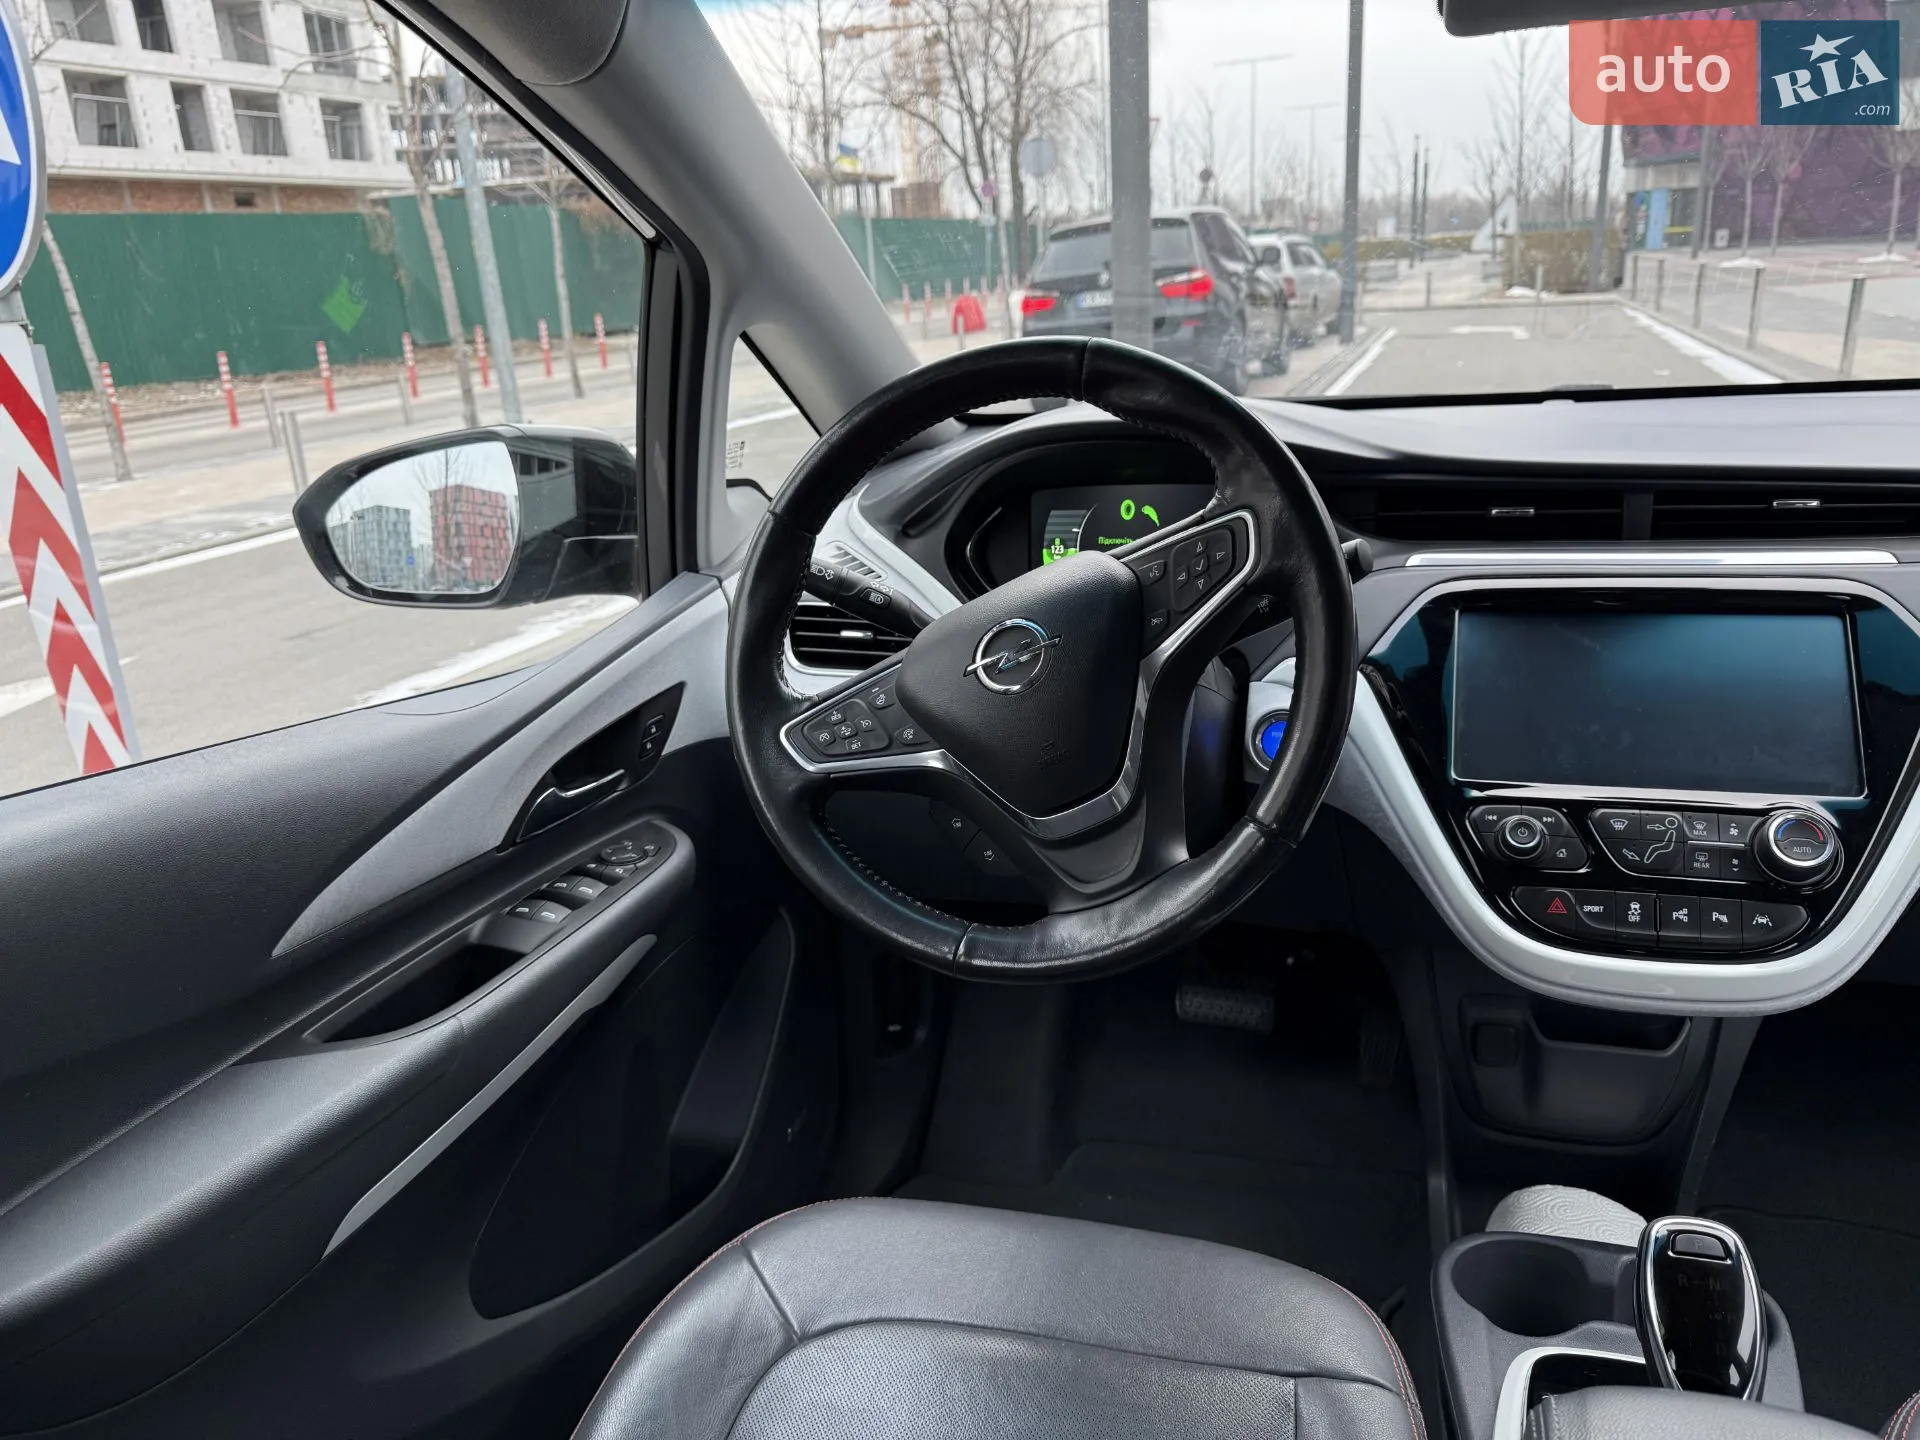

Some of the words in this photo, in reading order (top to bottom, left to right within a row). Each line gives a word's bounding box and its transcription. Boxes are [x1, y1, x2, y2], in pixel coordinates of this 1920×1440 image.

[1051, 545, 1064, 554] 123
[1792, 846, 1812, 854] AUTO
[1583, 905, 1604, 913] SPORT
[1628, 915, 1641, 923] OFF
